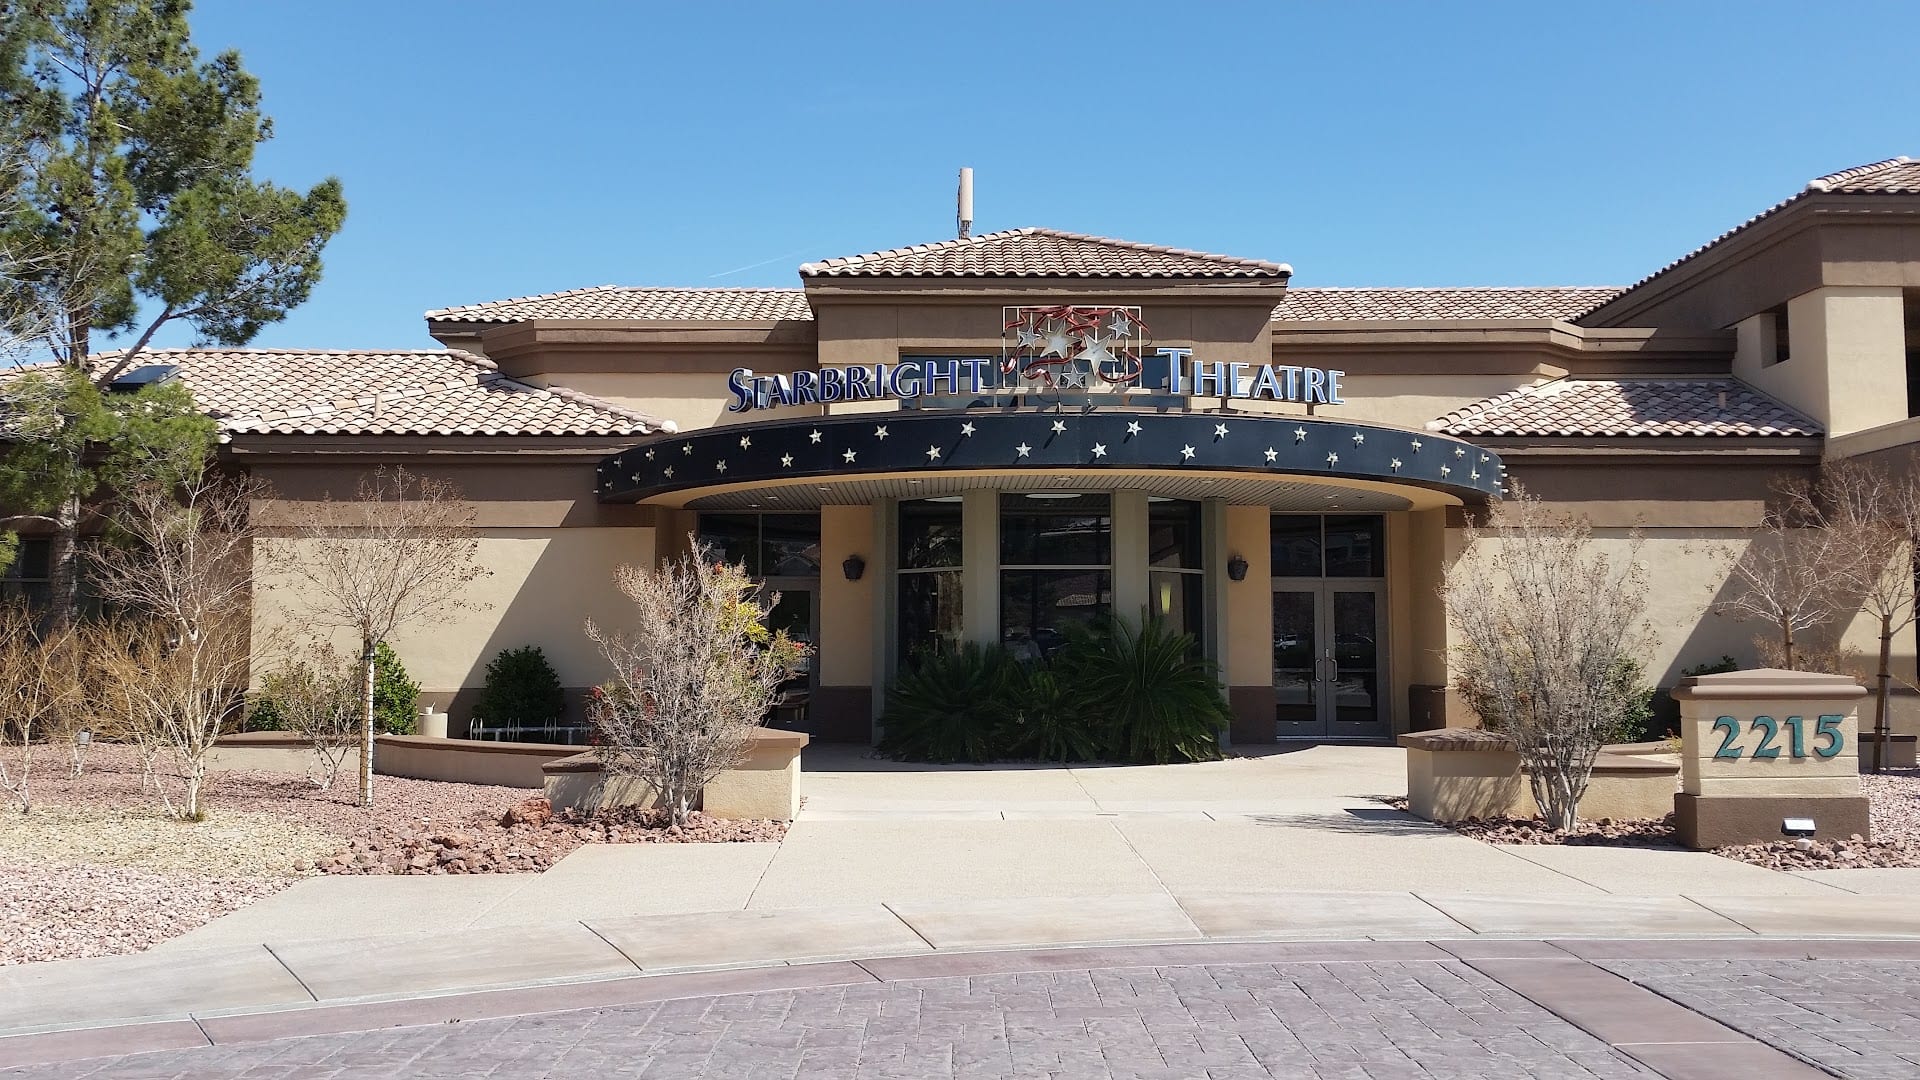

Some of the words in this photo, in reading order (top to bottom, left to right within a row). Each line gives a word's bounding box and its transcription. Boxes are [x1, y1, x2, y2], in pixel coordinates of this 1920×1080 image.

[728, 358, 990, 413] STARBRIGHT
[1157, 347, 1346, 405] THEATRE
[1712, 714, 1845, 758] 2215
